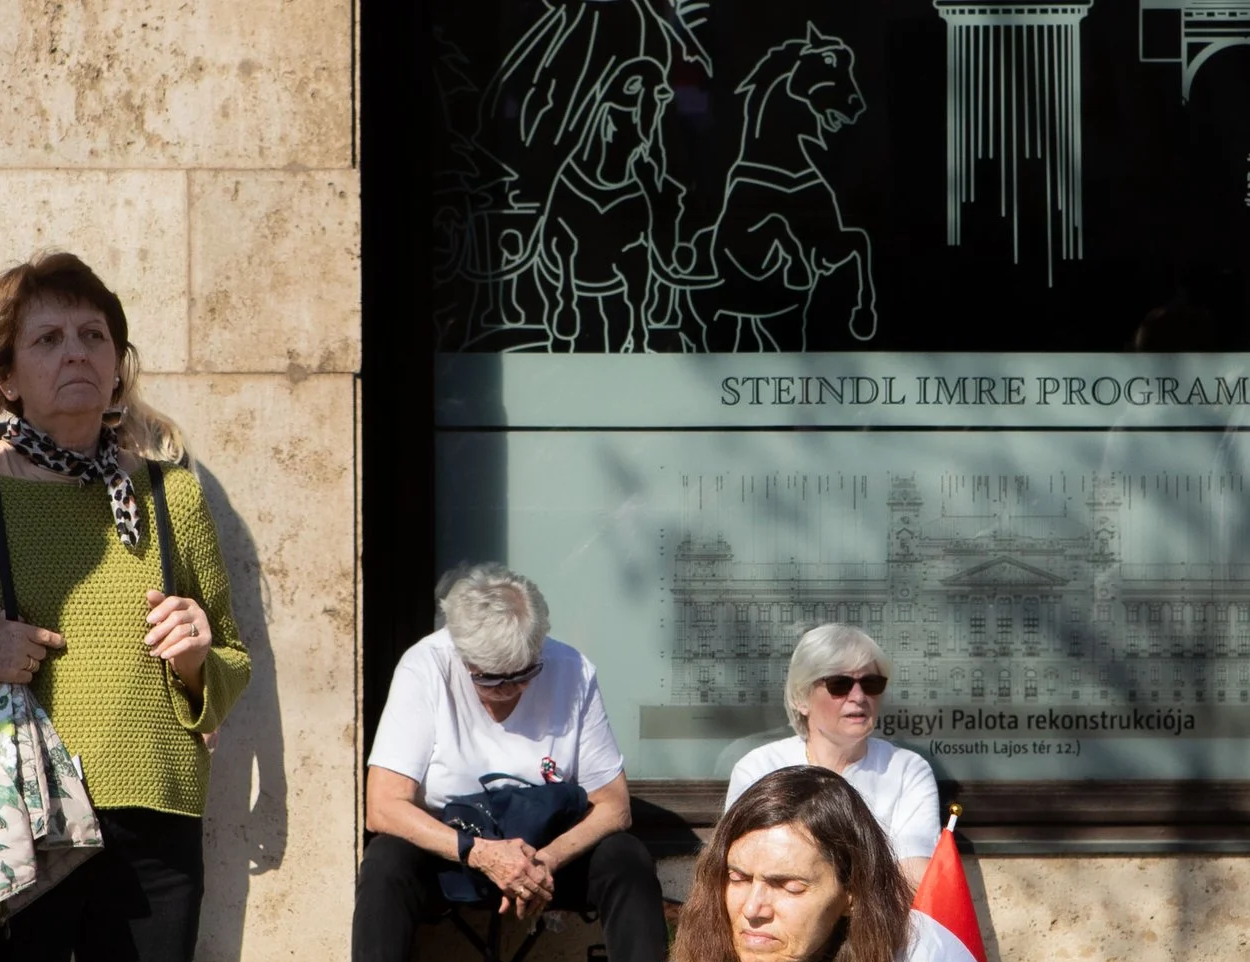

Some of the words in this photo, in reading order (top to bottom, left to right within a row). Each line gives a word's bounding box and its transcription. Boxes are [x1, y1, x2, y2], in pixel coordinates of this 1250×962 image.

[721, 376, 906, 406] STEINDL
[916, 376, 1026, 405] IMRE
[1036, 376, 1250, 406] PROGRAM
[952, 709, 1019, 731] Palota
[1027, 708, 1196, 737] rekonstrukciója
[930, 740, 988, 756] (Kossuth
[994, 740, 1028, 758] Lajos
[1033, 740, 1051, 755] tér
[1056, 740, 1081, 756] 12.)
